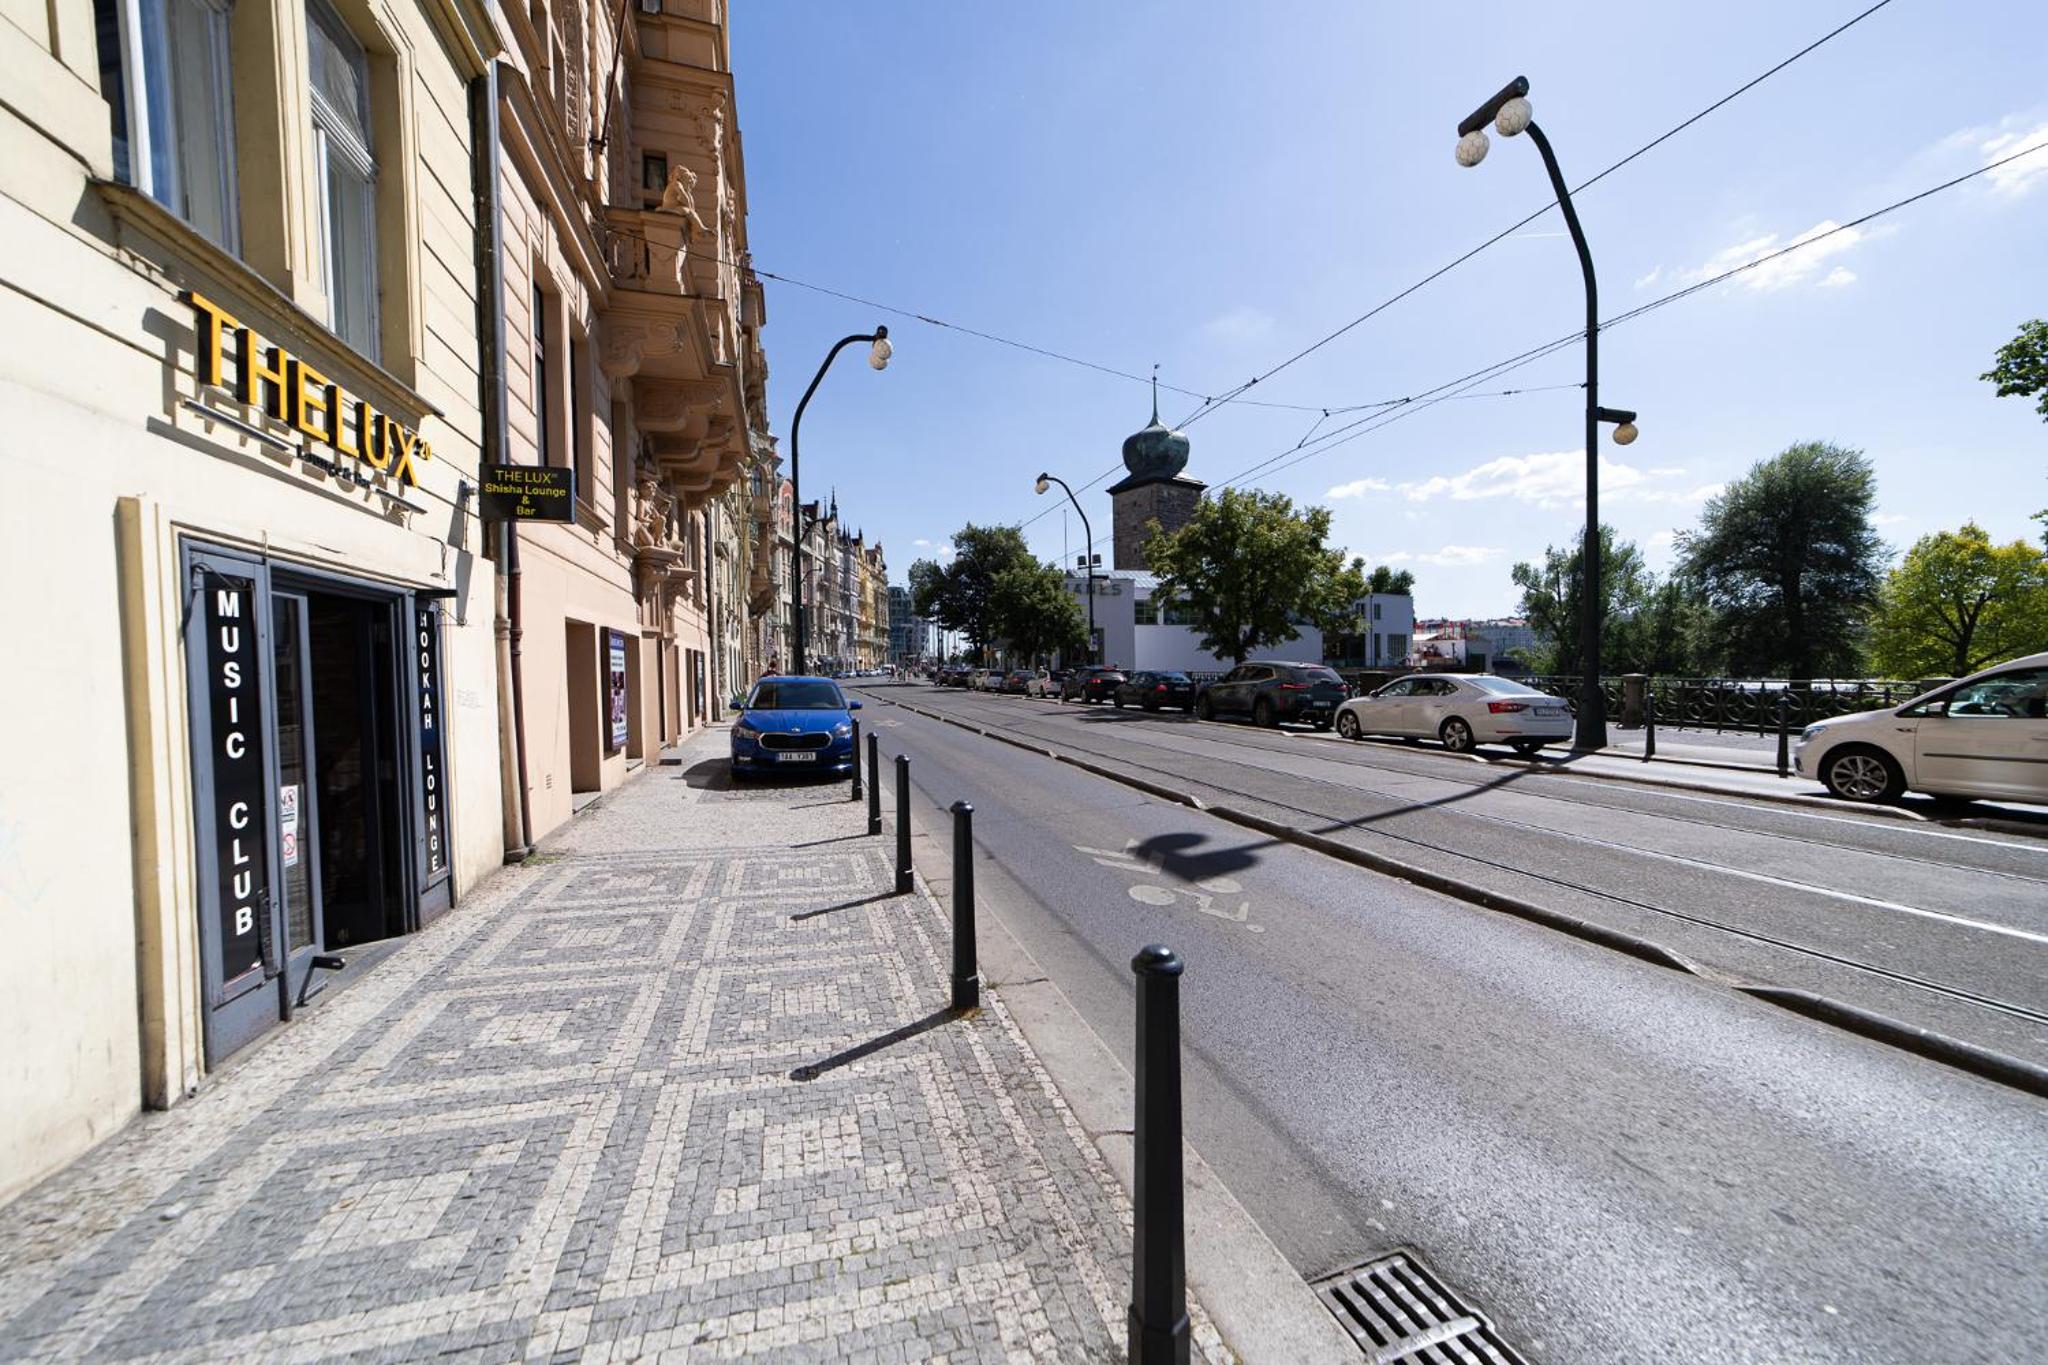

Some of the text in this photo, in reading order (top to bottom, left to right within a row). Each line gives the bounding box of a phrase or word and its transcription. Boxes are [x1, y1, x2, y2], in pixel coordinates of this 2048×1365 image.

[485, 483, 566, 498] Shisha Lounge
[522, 495, 530, 504] &
[517, 506, 536, 515] Bar
[420, 612, 439, 872] HOOKAH LOUNGE
[217, 590, 253, 937] MUSIC CLUB
